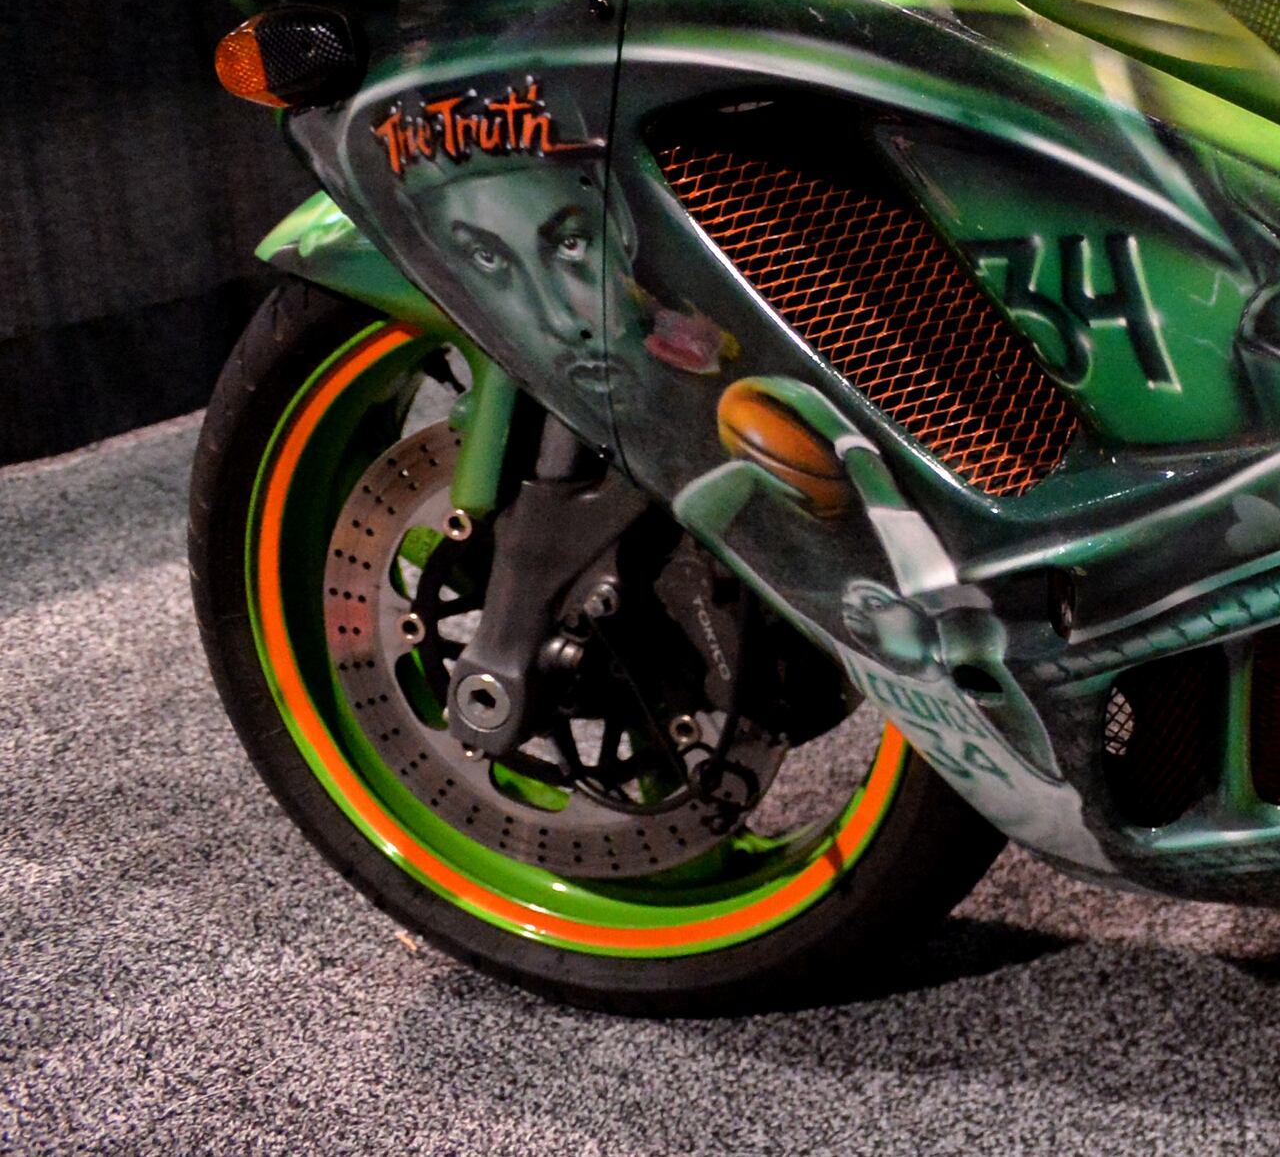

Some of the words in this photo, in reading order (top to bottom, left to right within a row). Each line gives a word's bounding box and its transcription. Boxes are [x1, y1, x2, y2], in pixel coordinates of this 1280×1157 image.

[423, 77, 606, 159] Truth
[955, 234, 1183, 394] 34
[692, 594, 732, 681] TOKICO
